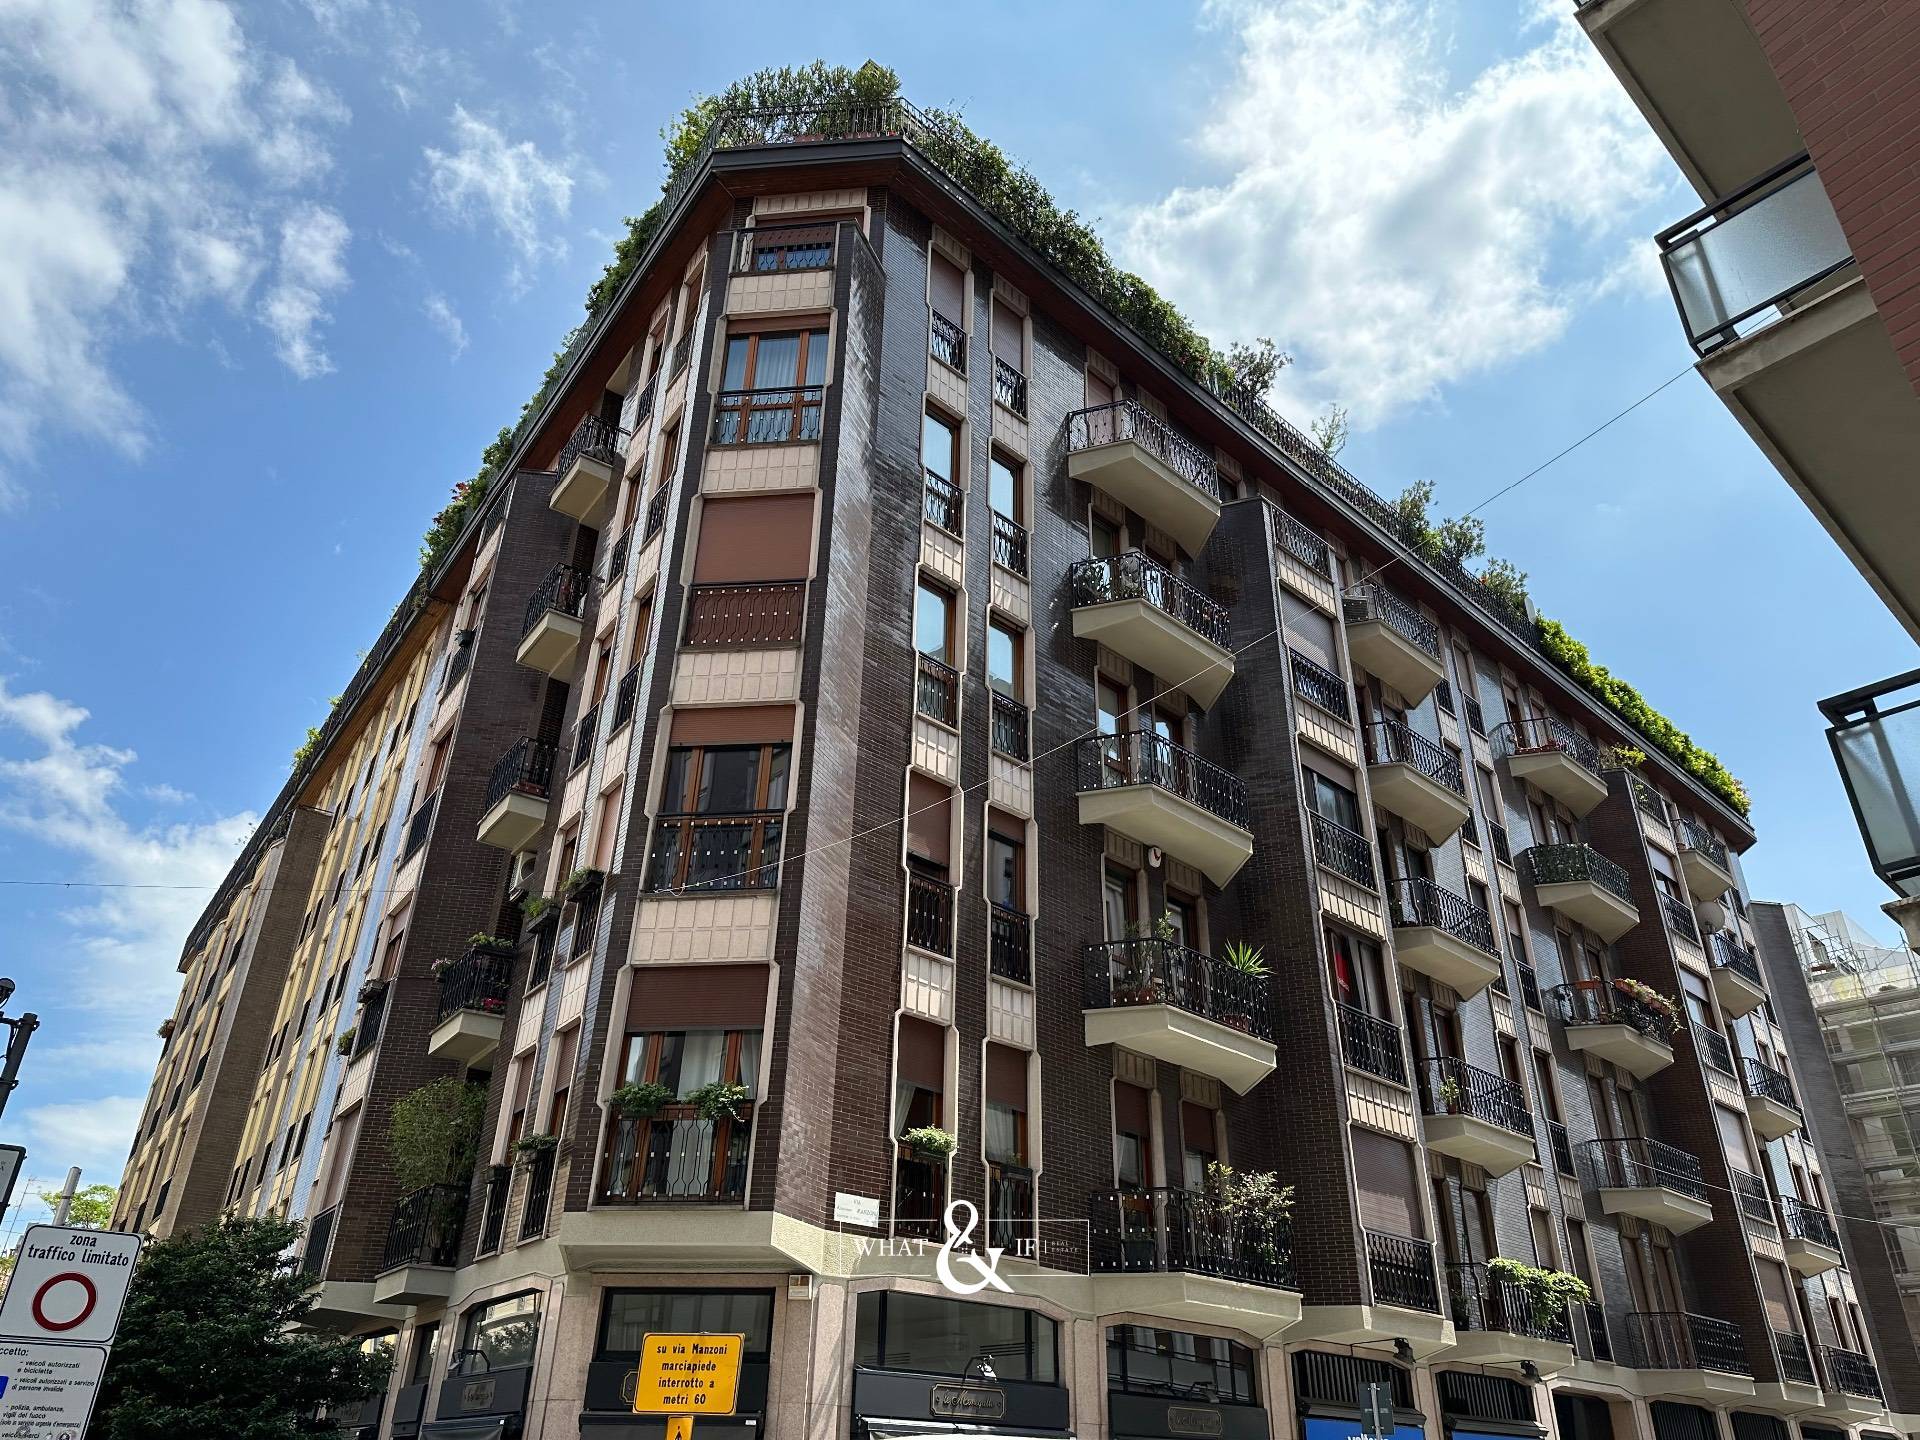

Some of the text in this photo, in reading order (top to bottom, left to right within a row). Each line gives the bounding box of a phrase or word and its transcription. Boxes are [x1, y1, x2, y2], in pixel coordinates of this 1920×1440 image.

[70, 1235, 97, 1247] zona
[28, 1244, 129, 1266] traffico limitato
[0, 1347, 29, 1356] ccetto:
[657, 1343, 728, 1354] su via Manzoni
[662, 1360, 716, 1373] marciapiede
[658, 1377, 715, 1388] interrotto a
[663, 1393, 706, 1404] metri 60
